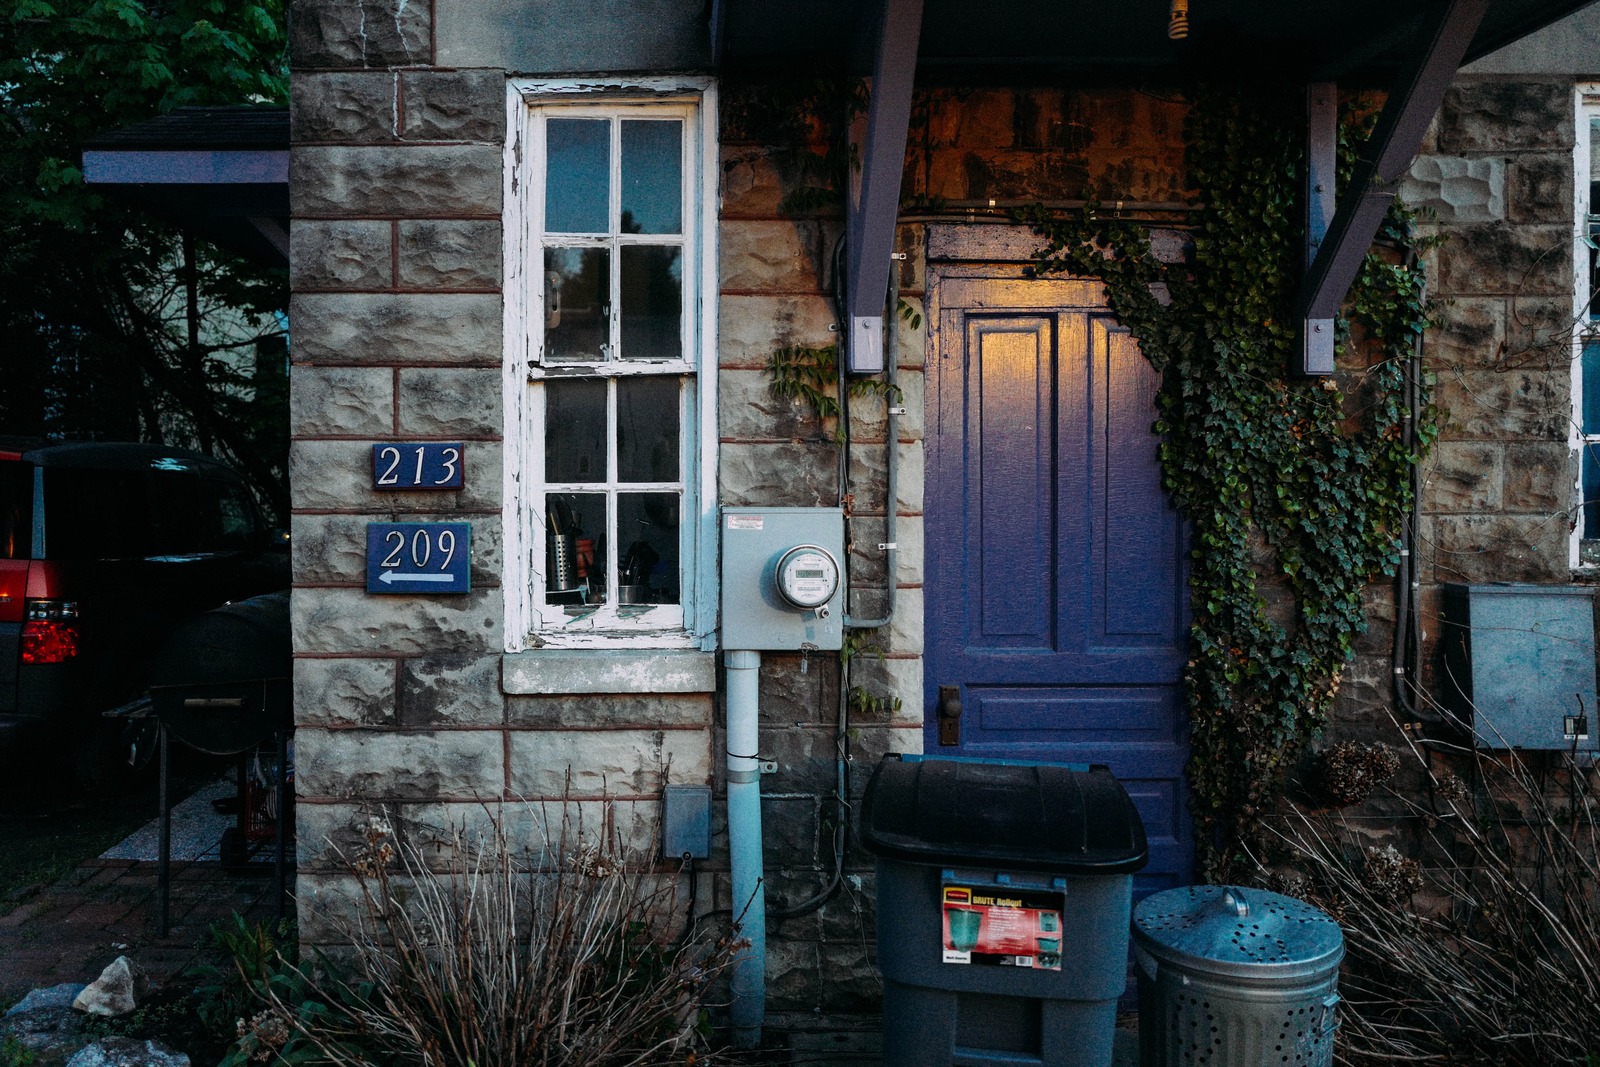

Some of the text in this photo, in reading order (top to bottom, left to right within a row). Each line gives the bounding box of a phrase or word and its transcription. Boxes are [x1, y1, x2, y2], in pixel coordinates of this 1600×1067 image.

[377, 446, 459, 485] 213
[380, 529, 456, 570] 209
[972, 896, 994, 905] BRUTE
